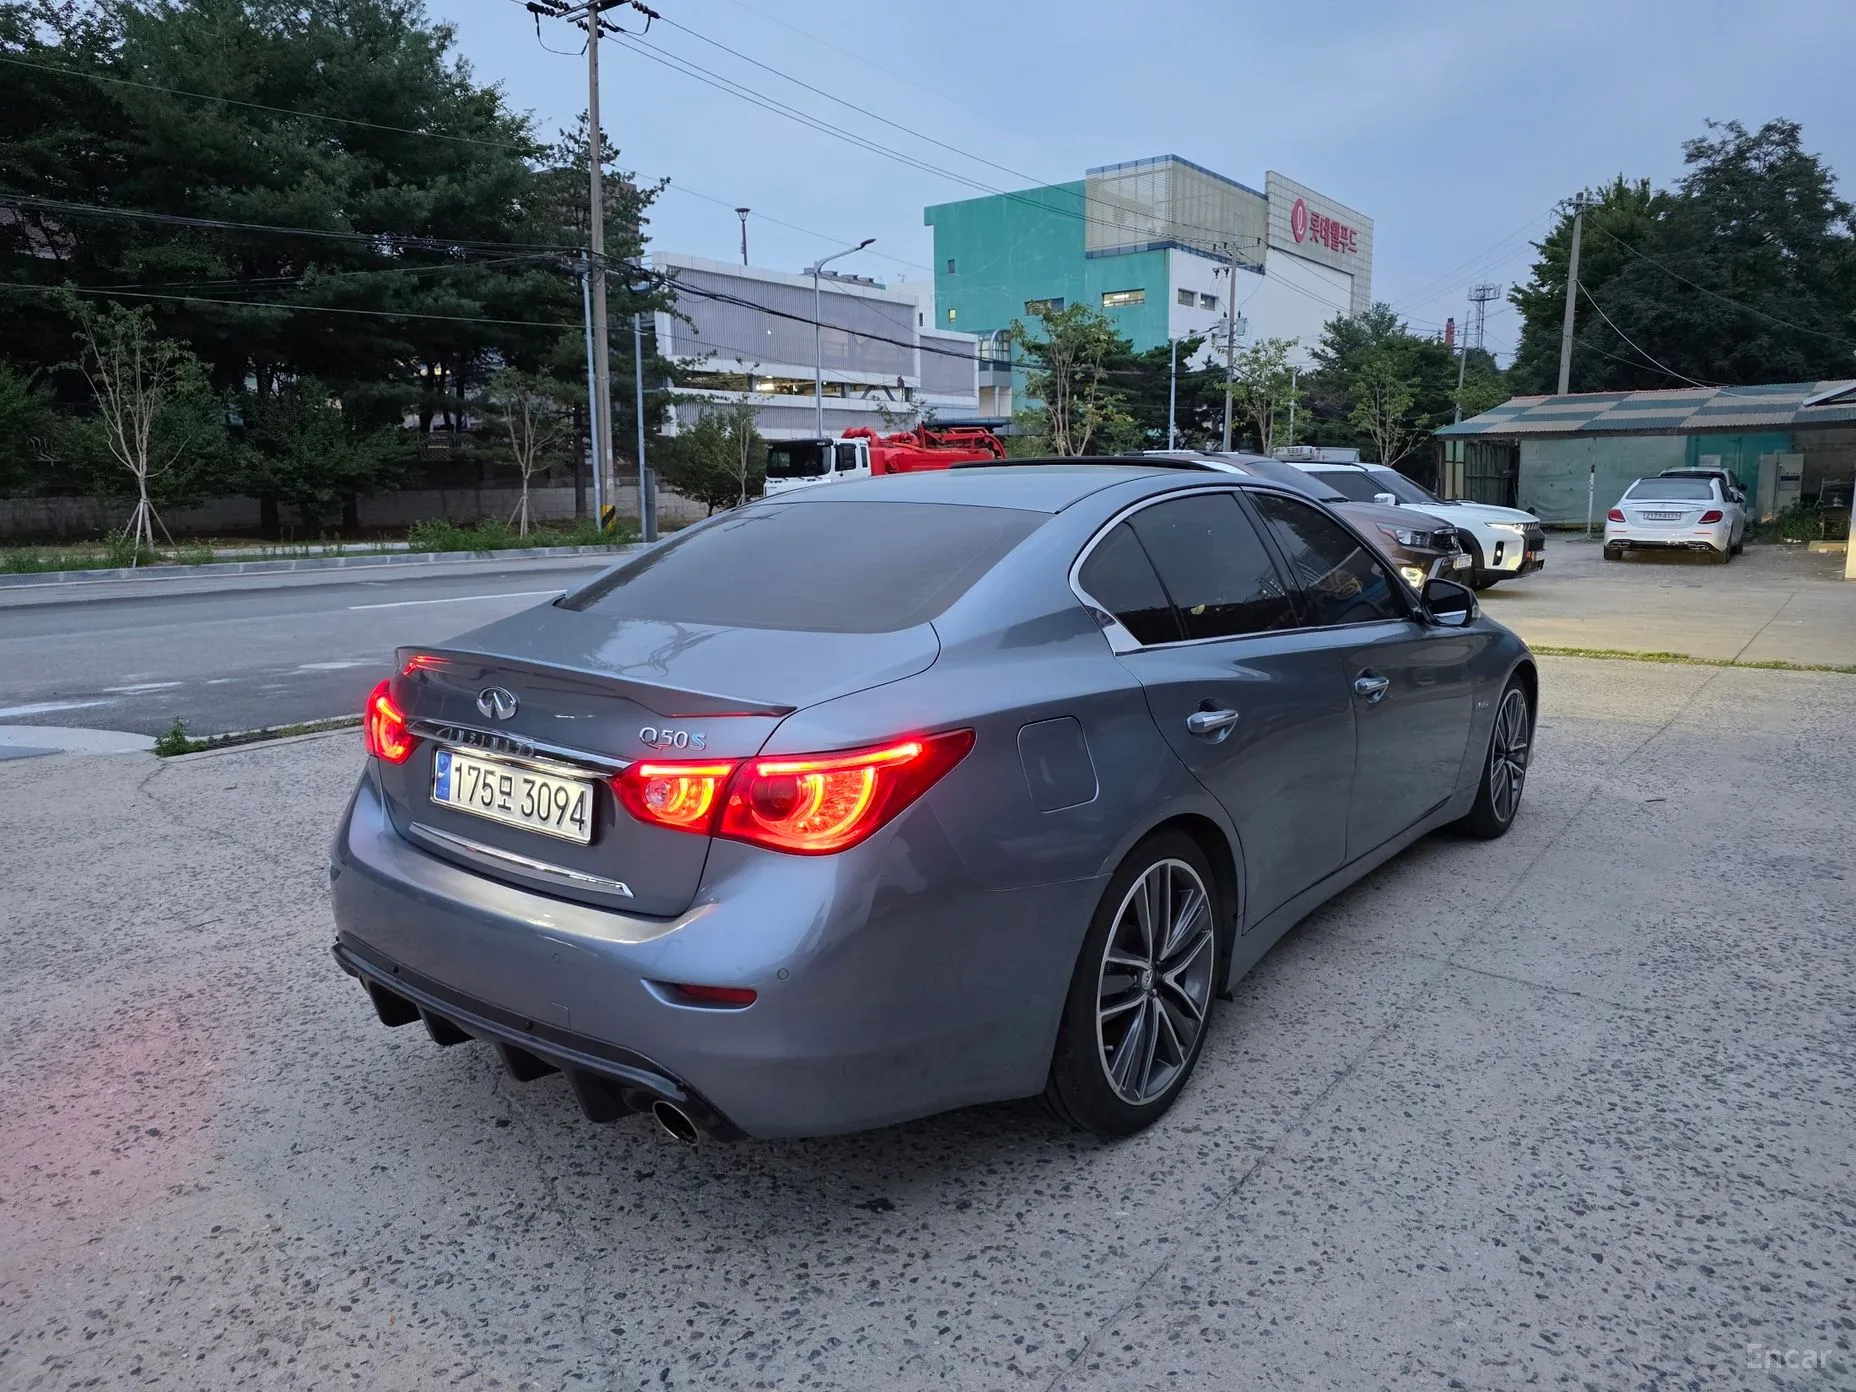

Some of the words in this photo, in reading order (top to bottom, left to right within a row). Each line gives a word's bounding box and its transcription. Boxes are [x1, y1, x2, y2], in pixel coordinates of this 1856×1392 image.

[1309, 211, 1358, 254] 롯데웰푸드
[639, 726, 707, 751] Q50S
[454, 762, 514, 811] 175모
[521, 777, 586, 831] 3094
